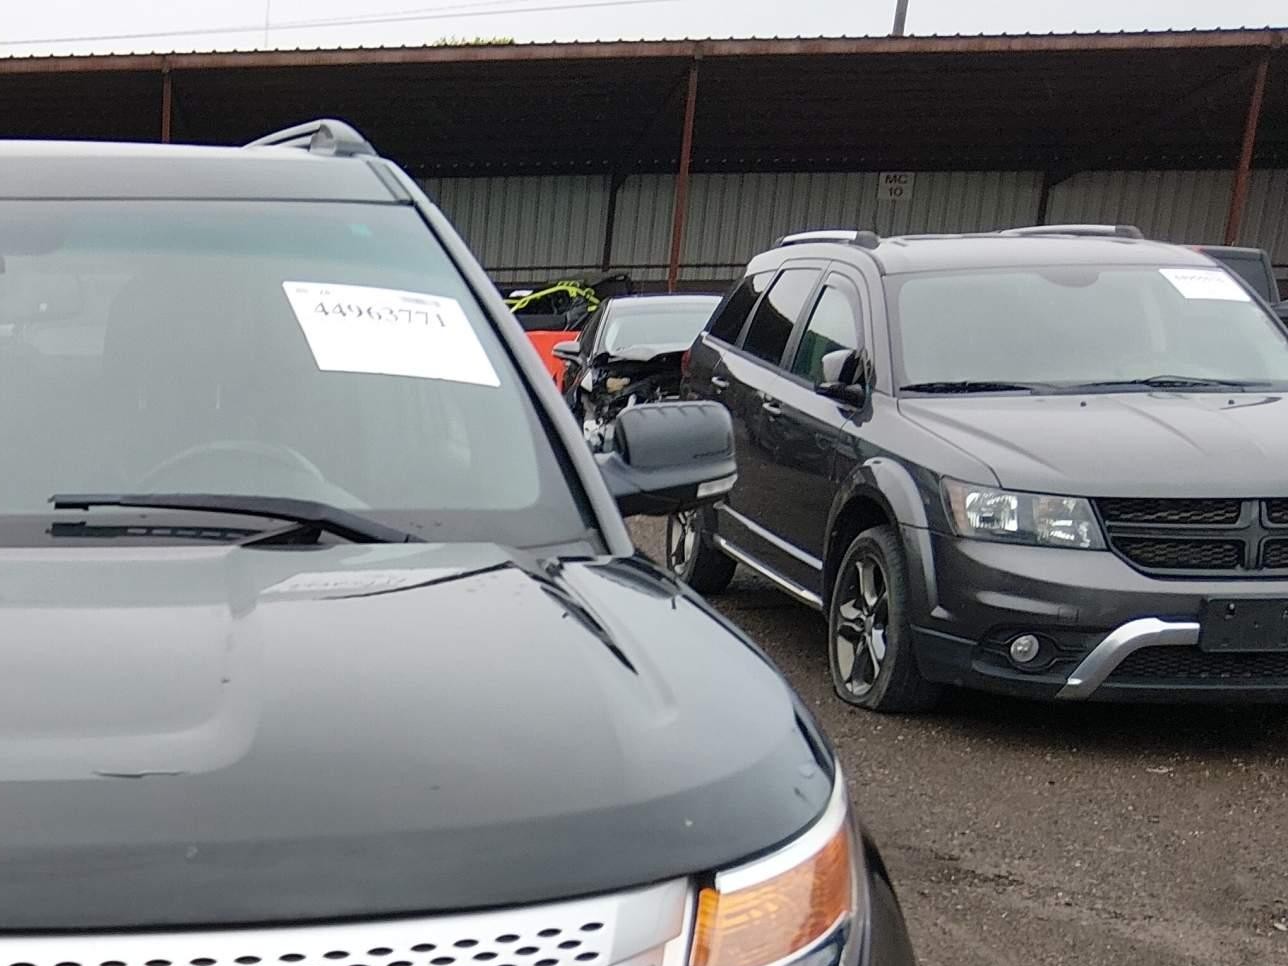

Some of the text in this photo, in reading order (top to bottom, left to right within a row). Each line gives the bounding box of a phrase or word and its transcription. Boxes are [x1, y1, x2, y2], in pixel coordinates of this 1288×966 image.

[885, 174, 908, 184] MC
[889, 186, 904, 197] 10
[314, 301, 447, 328] 44963771
